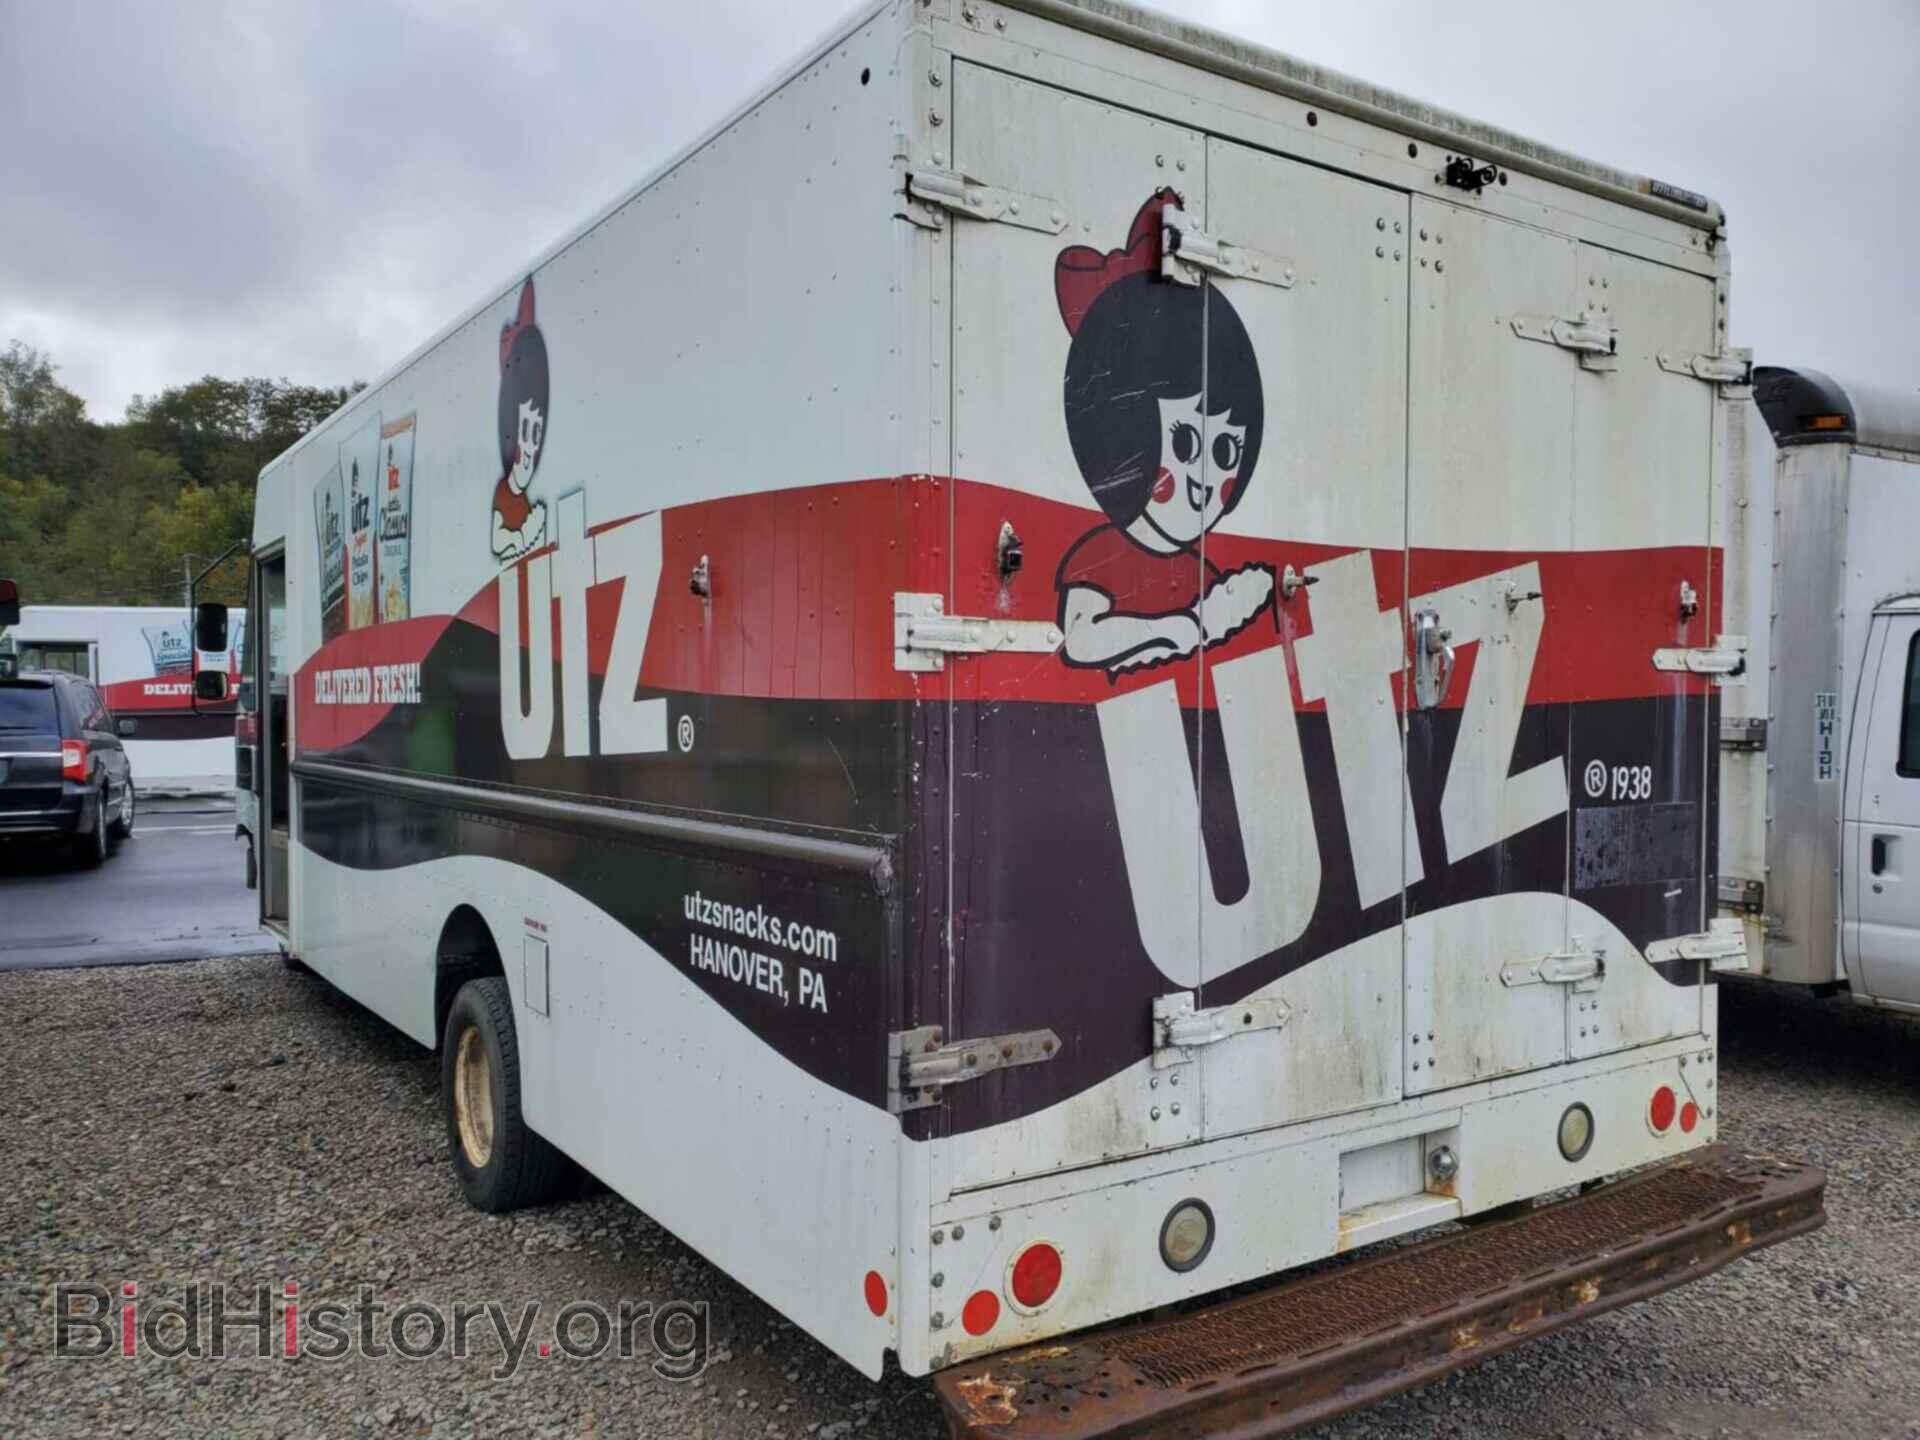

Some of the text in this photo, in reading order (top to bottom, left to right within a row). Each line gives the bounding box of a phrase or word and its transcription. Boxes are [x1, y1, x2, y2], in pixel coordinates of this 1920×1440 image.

[143, 683, 192, 695] DELIV
[315, 662, 421, 704] DELIVERED FRESH!
[1611, 765, 1652, 800] 1938
[684, 890, 837, 962] utzsnacks.com
[690, 933, 828, 1013] HANOVER, PA
